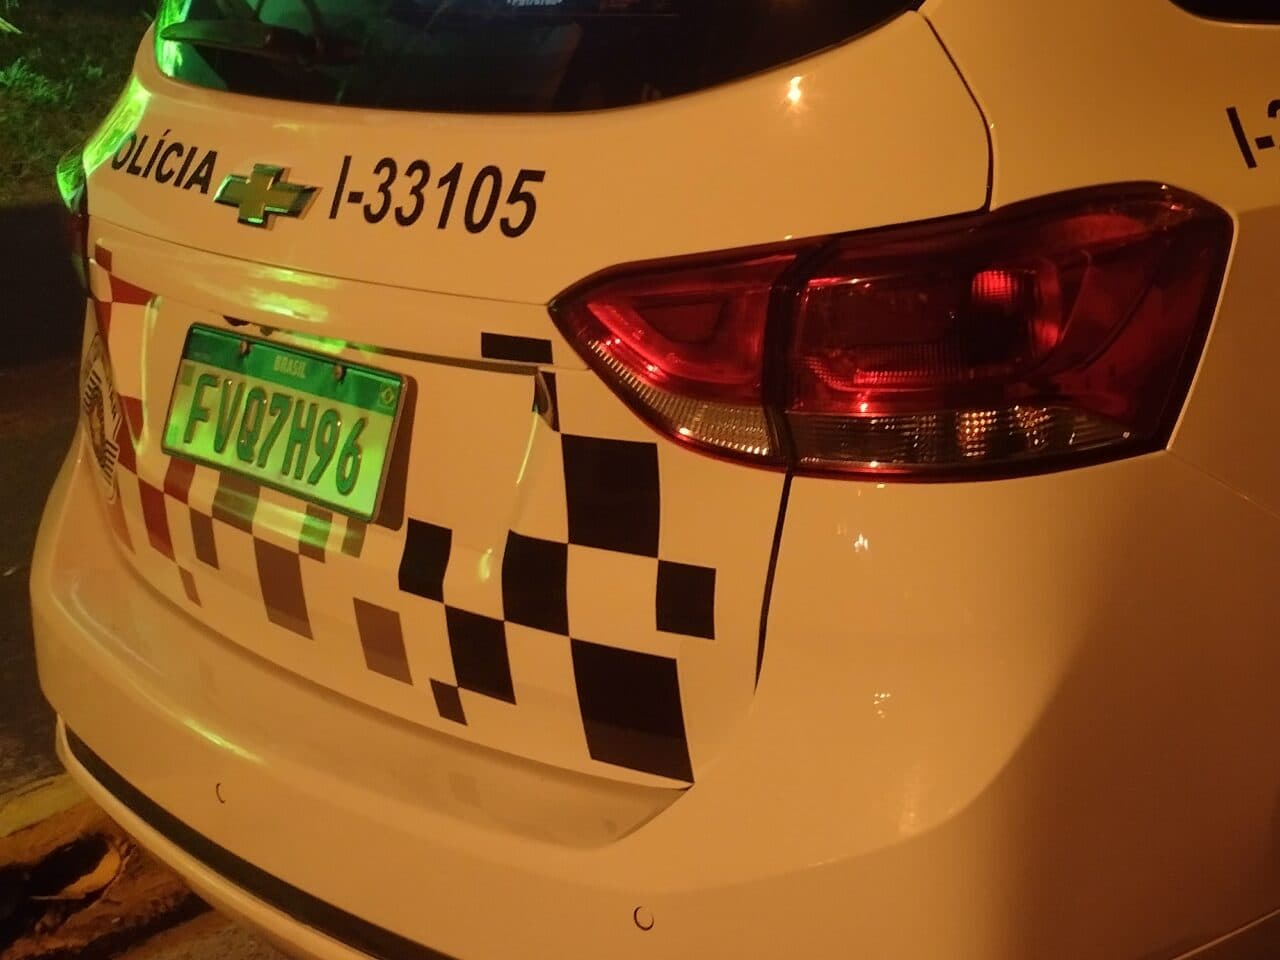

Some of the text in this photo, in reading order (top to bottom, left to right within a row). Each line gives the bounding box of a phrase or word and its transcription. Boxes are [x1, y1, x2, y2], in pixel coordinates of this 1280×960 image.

[110, 128, 546, 239] OLÍCIA I-33105
[273, 354, 307, 379] BRASIL
[183, 373, 368, 497] FVQ7H96
